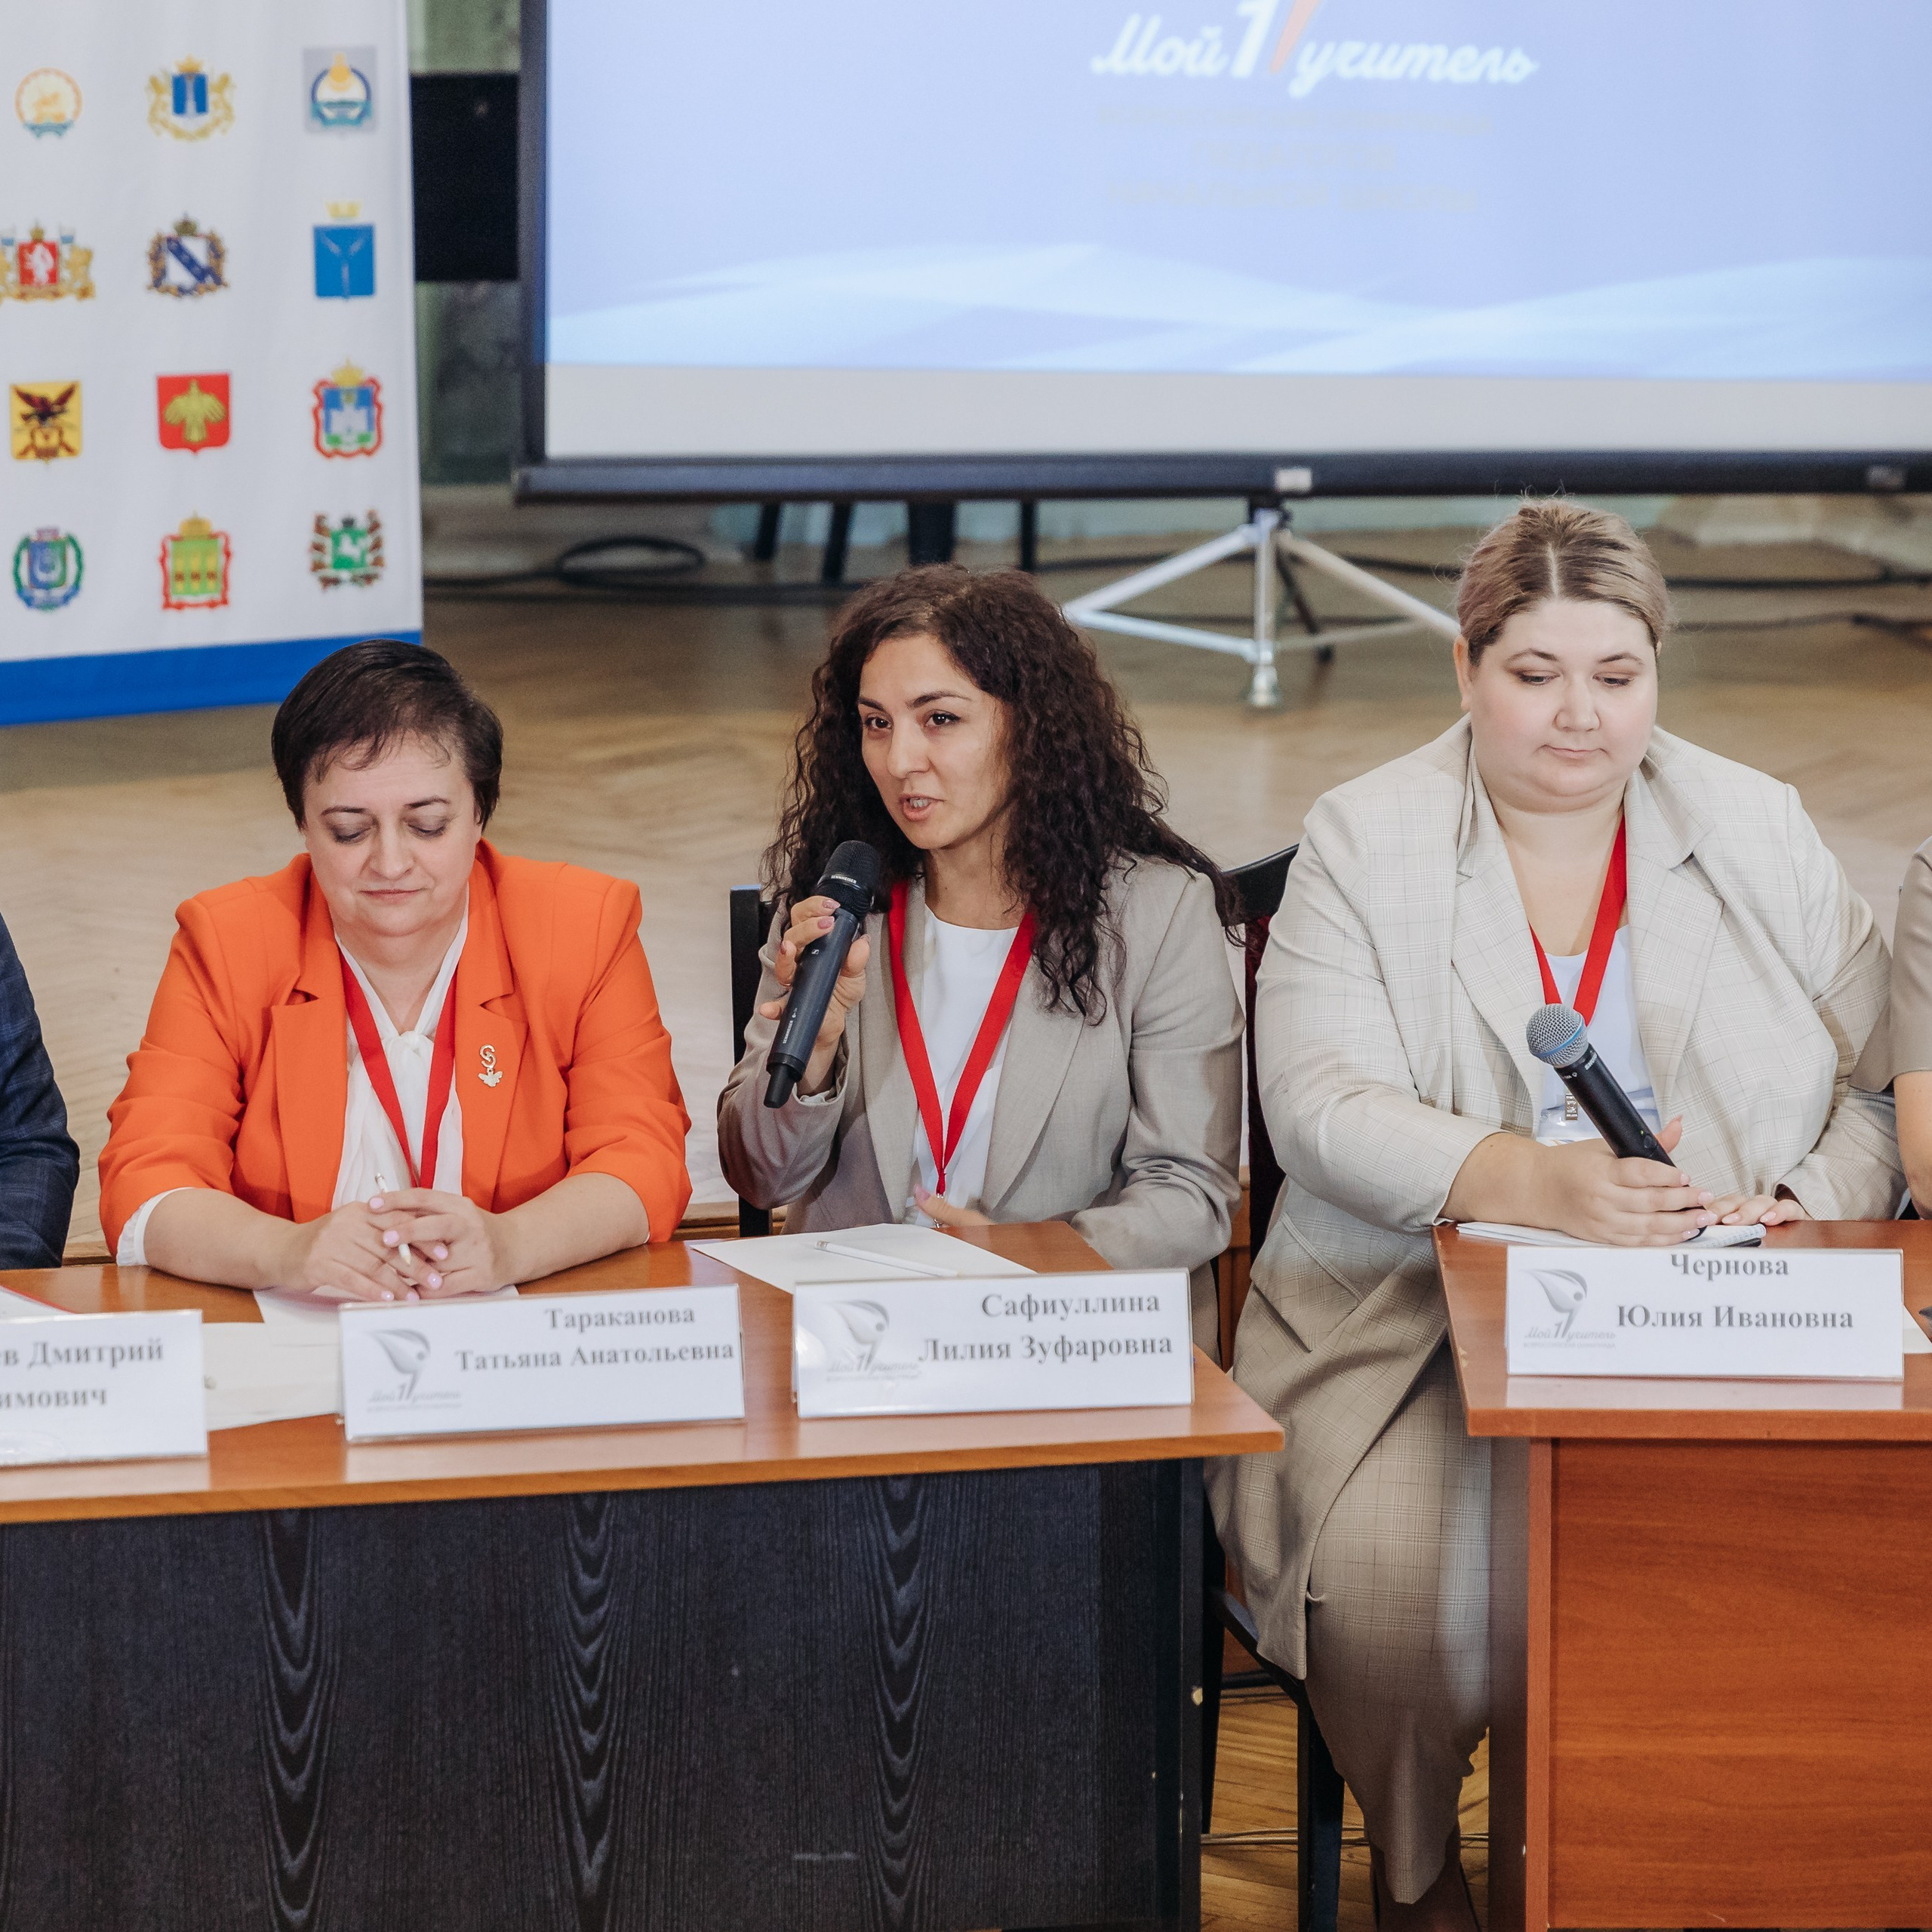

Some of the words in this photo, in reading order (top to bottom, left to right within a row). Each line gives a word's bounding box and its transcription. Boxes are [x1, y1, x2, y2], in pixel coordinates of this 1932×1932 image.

[1088, 11, 1230, 77] Мой
[1287, 39, 1541, 99] учитель
[1669, 1252, 1790, 1282] Чернова
[545, 1306, 696, 1335] Тараканова
[980, 1291, 1161, 1324] Сафиуллина
[1616, 1303, 1704, 1329] Юлия
[1713, 1303, 1855, 1330] Ивановна
[26, 1337, 165, 1371] Дмитрий
[456, 1349, 563, 1373] Татьяна
[571, 1342, 735, 1367] Анатольевна
[918, 1337, 1013, 1362] Лилия
[1020, 1333, 1174, 1366] Зуфаровна
